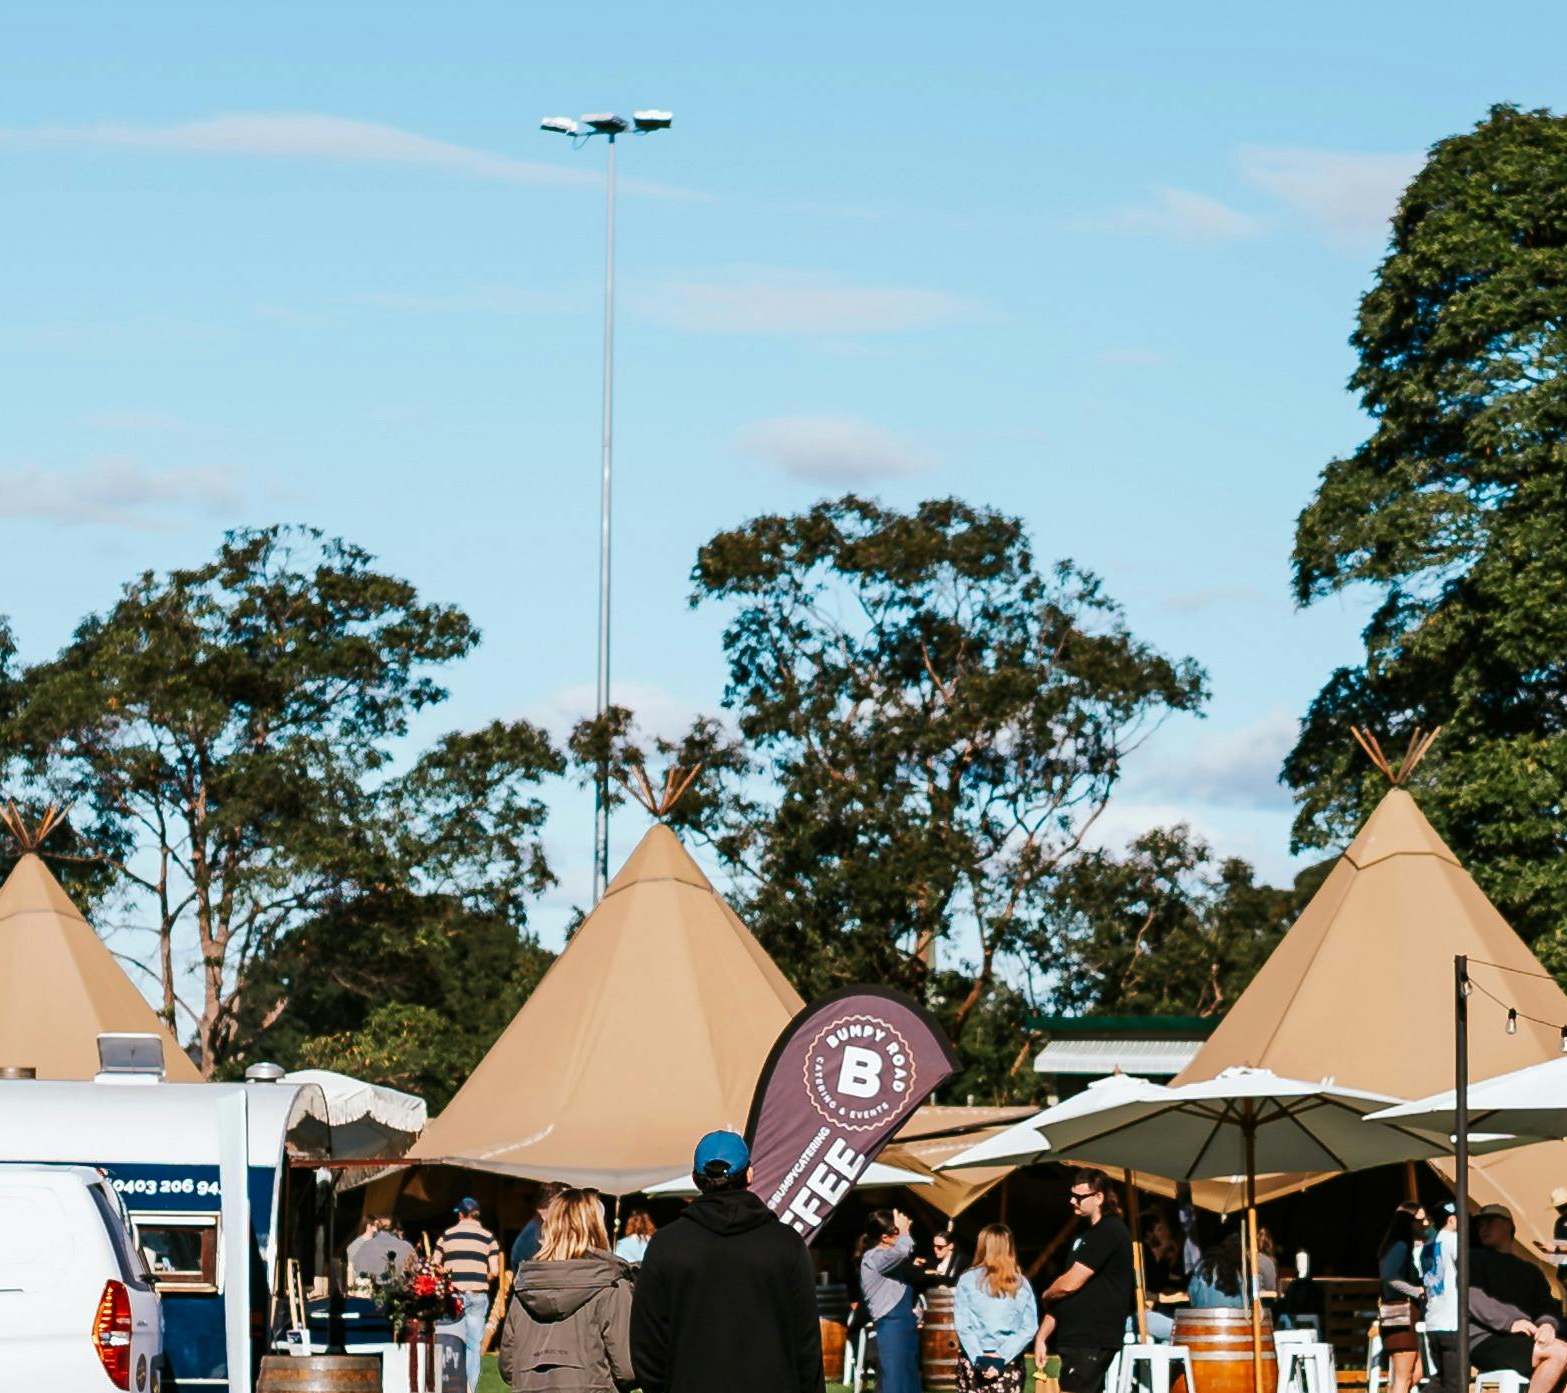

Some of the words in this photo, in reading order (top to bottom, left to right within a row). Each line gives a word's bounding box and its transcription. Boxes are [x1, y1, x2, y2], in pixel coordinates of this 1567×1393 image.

[826, 1024, 885, 1048] BUMPY
[886, 1041, 907, 1092] ROAD
[837, 1045, 883, 1098] B
[814, 1056, 837, 1109] CATERING
[839, 1107, 846, 1116] &
[849, 1101, 889, 1119] EVENTS
[113, 1179, 158, 1195] 0403
[159, 1178, 194, 1194] 206
[196, 1180, 222, 1196] 94
